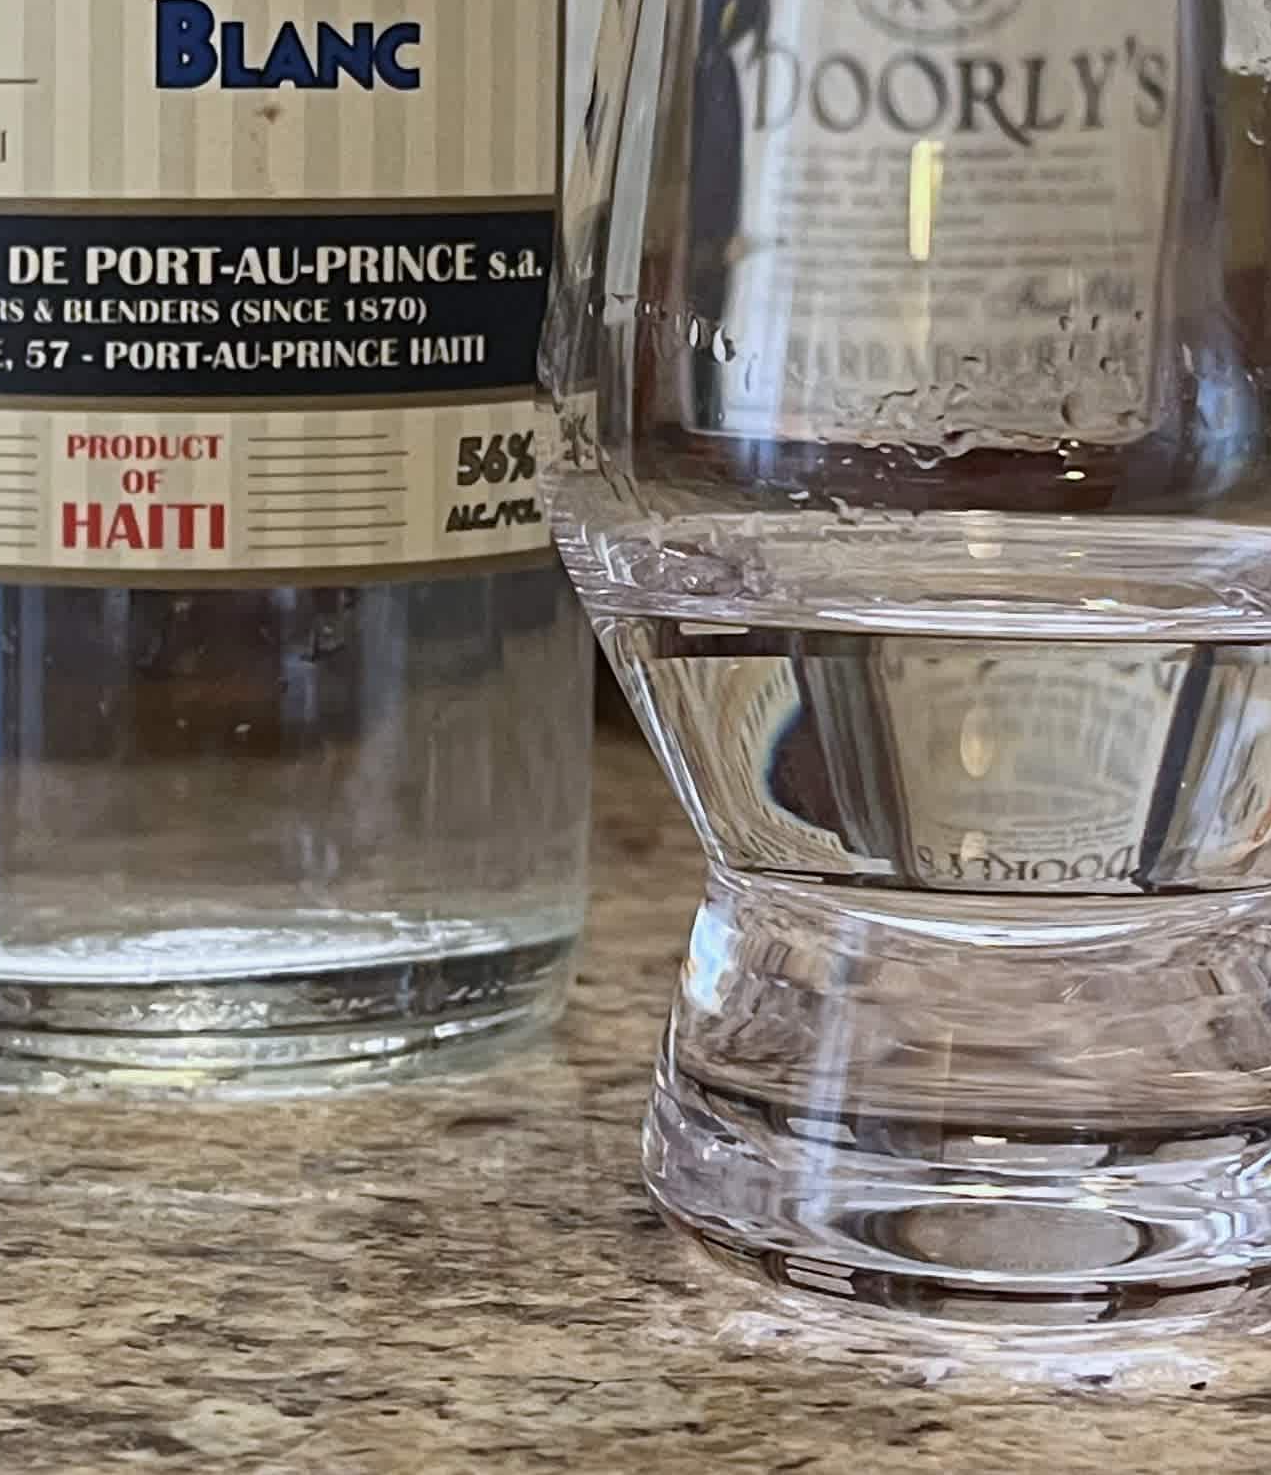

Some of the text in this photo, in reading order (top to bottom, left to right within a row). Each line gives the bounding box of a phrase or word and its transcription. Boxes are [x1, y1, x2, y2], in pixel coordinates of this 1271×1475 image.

[7, 245, 70, 286] DE
[84, 243, 477, 286] PORT-AU-PRINCE
[487, 247, 544, 280] s.a.
[33, 297, 54, 324] &
[63, 298, 220, 325] BLENDERS
[230, 297, 331, 328] (SINCE
[343, 296, 428, 326] 1870)
[24, 340, 70, 369] 57
[104, 337, 400, 371] PORT-AU-PRINCE
[409, 334, 486, 365] HAITI
[66, 433, 225, 461] PRODUCT
[456, 428, 537, 487] 56%
[121, 467, 168, 494] OF
[61, 501, 226, 550] HAITI
